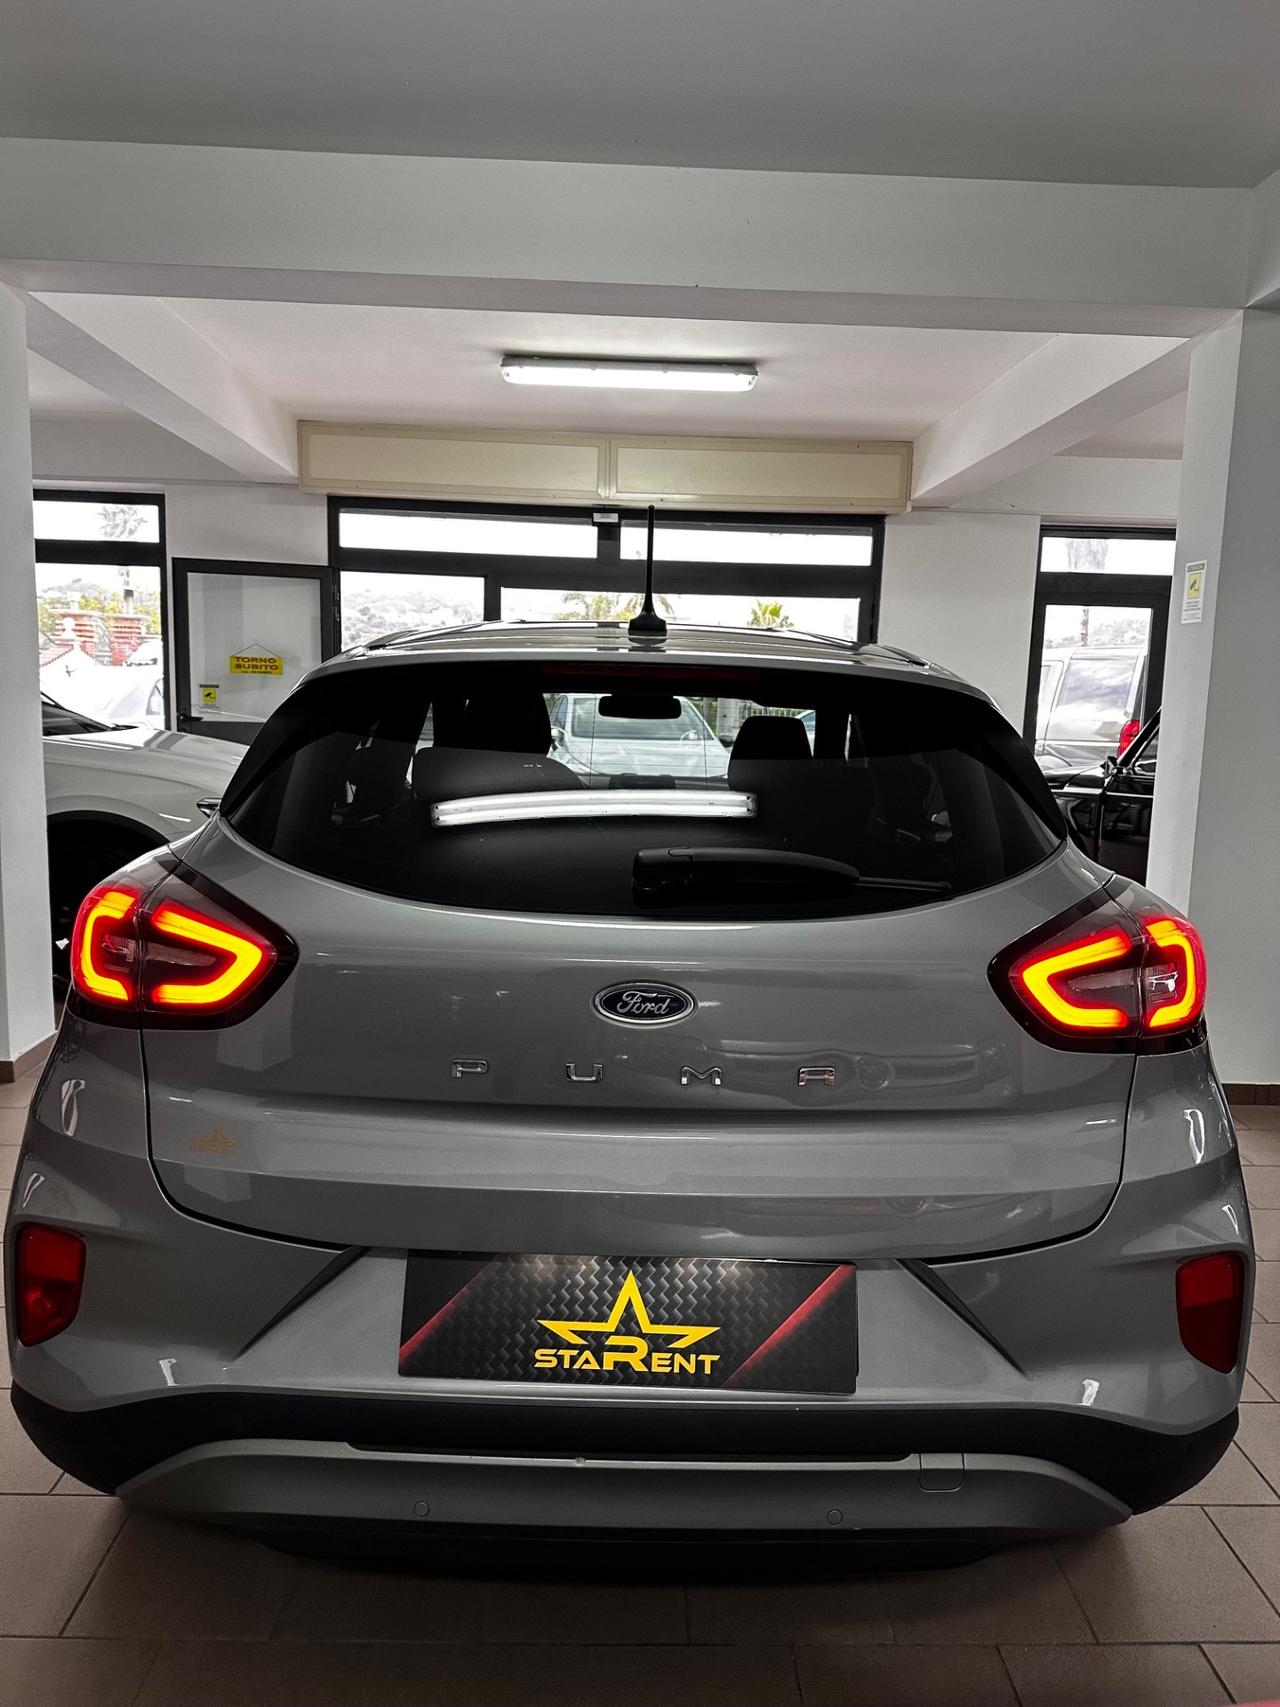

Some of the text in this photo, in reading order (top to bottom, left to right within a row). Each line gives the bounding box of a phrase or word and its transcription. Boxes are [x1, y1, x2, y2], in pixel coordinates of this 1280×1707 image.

[234, 656, 277, 664] TORNO
[235, 663, 279, 671] SUBITO
[616, 990, 675, 1015] Ford
[451, 1058, 836, 1086] PUMA
